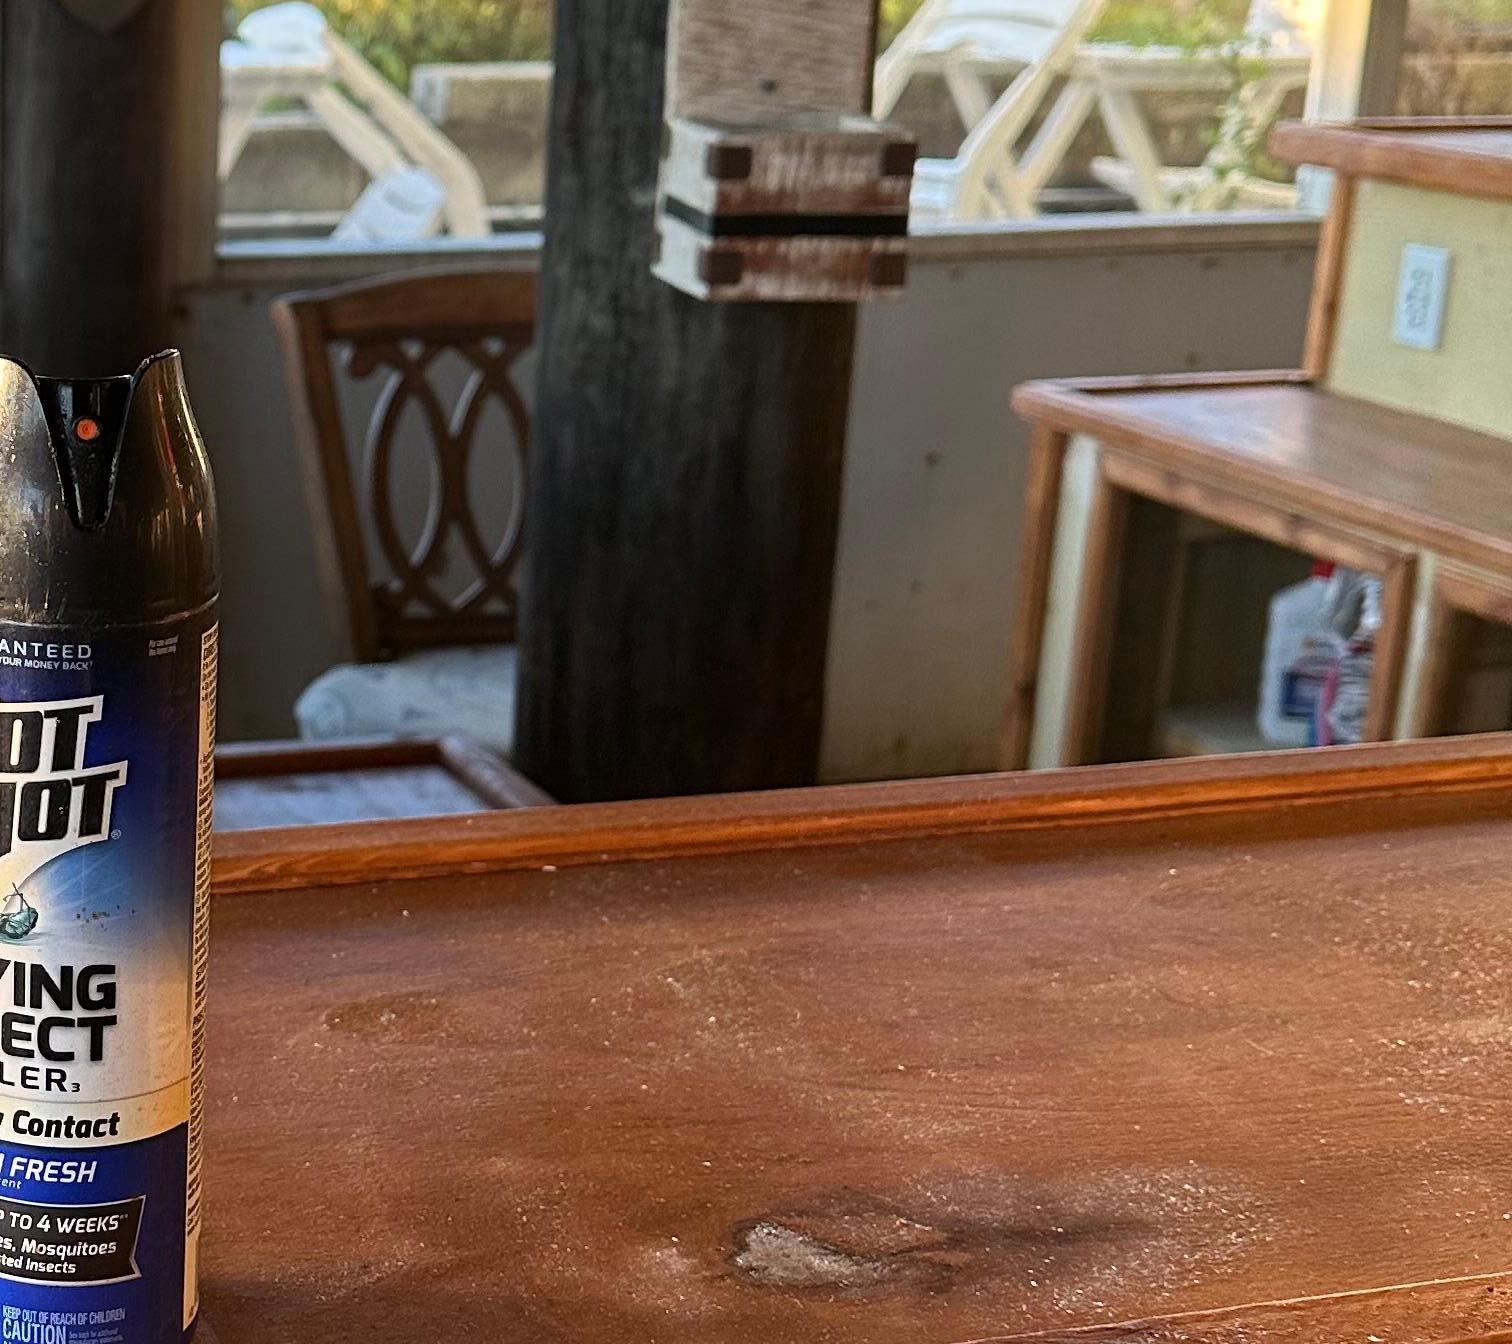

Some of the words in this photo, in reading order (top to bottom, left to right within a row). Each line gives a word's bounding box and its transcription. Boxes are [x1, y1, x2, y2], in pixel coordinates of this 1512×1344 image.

[24, 658, 60, 670] MONEY
[12, 1109, 121, 1139] Contact
[9, 1155, 98, 1184] FRESH
[9, 1212, 33, 1231] TO
[36, 1214, 51, 1233] 4
[21, 1239, 118, 1261] Mosquitoes
[25, 1259, 76, 1274] Insects
[22, 1308, 38, 1323] OUT
[38, 1310, 49, 1325] OF
[50, 1311, 77, 1326] REACH
[77, 1312, 88, 1325] OF
